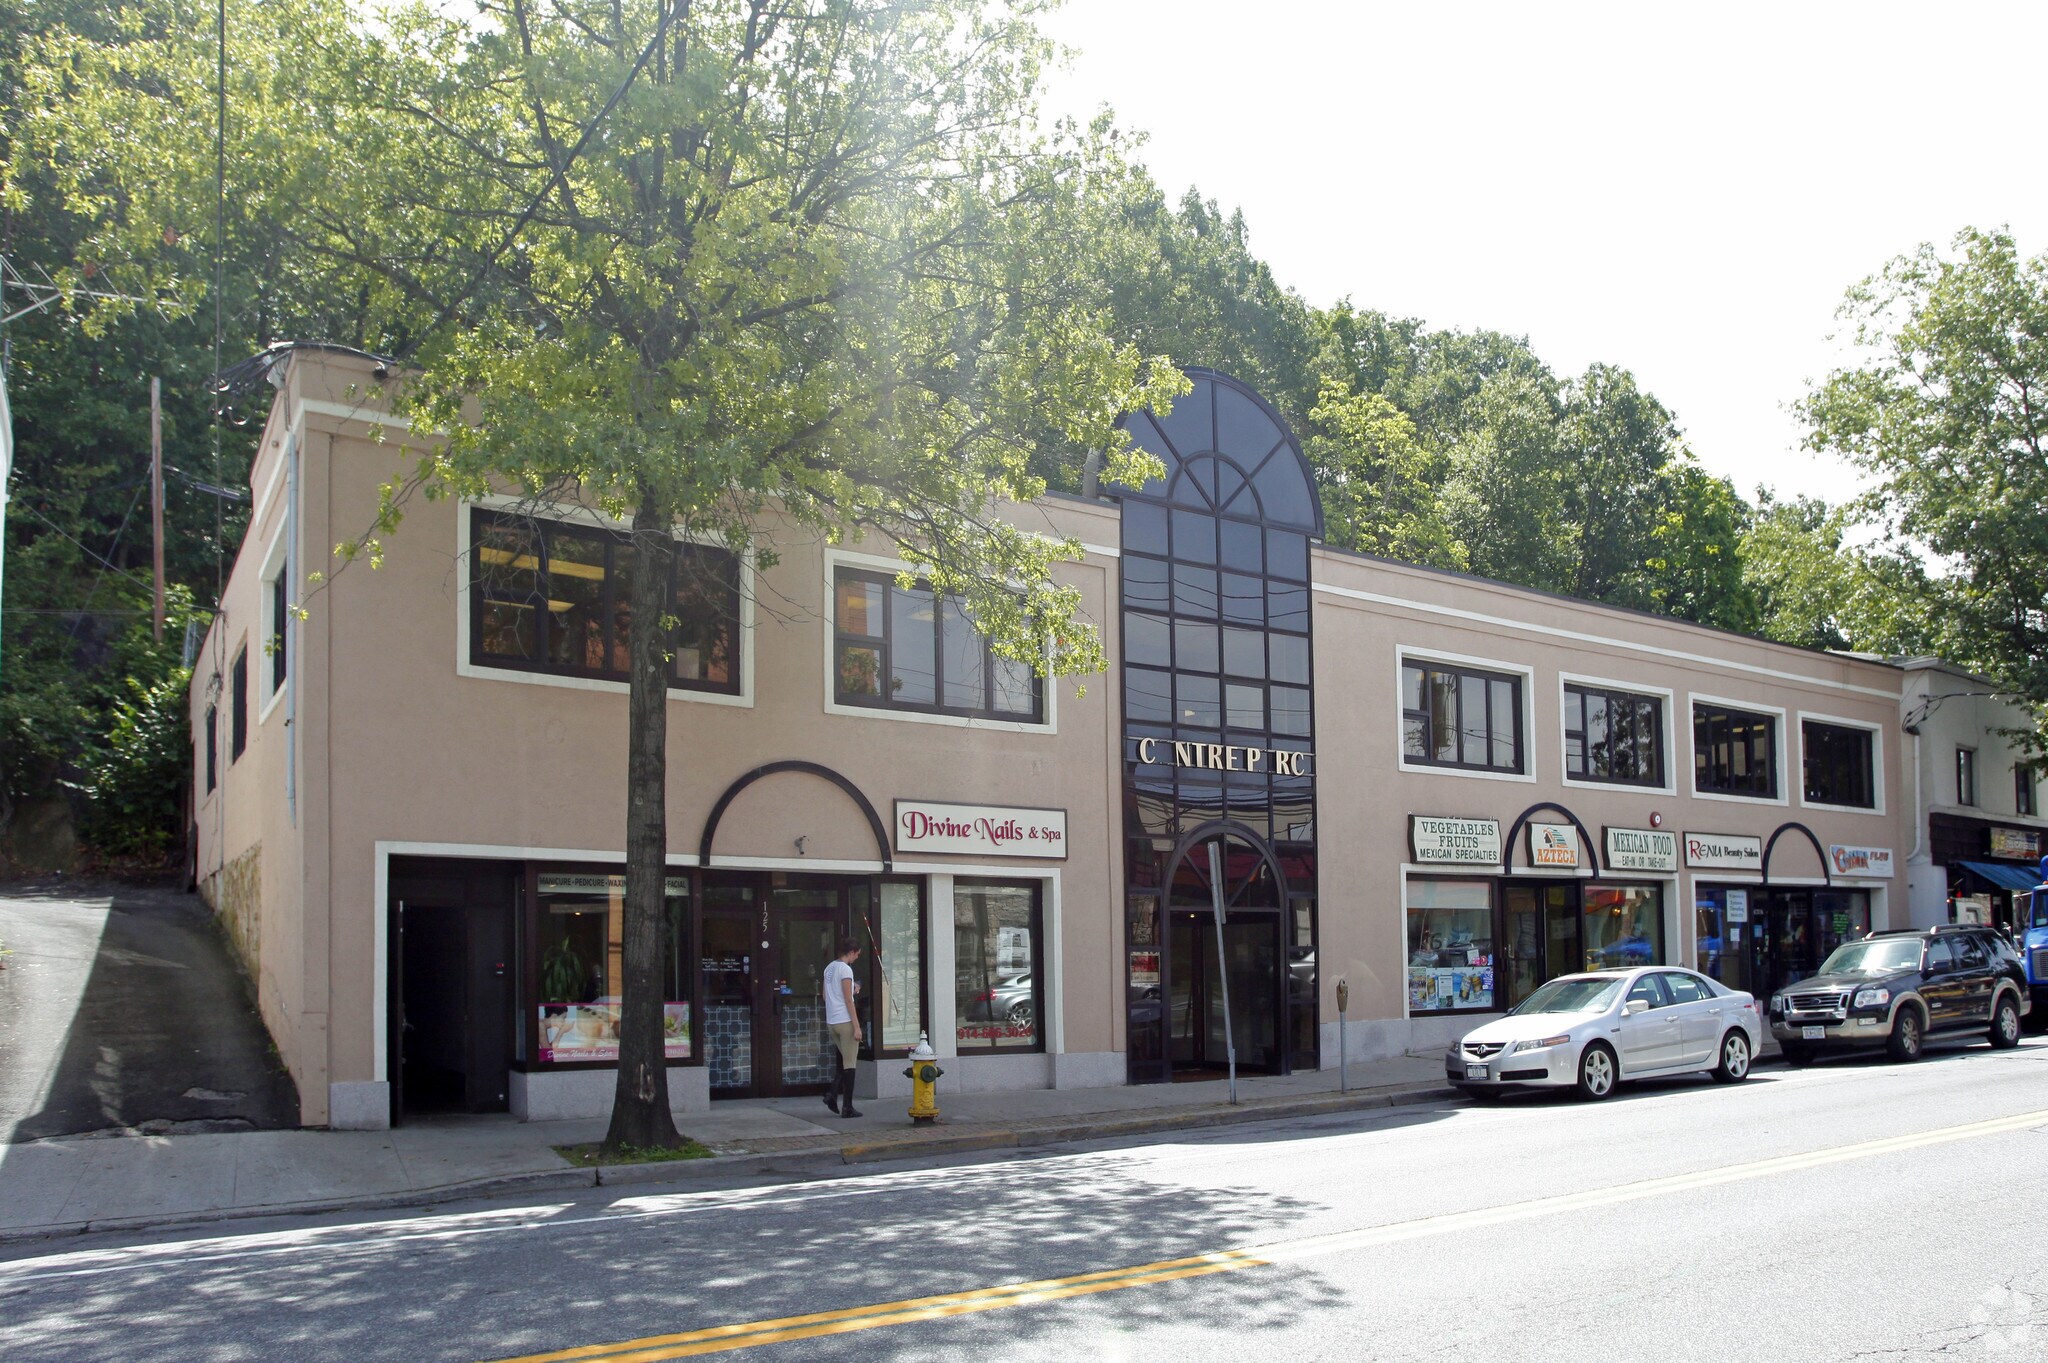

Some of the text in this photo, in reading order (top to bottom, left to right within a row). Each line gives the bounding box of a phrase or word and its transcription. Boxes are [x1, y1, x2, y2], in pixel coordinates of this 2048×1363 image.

[902, 811, 1061, 846] Divine Nails & Spa
[1421, 821, 1494, 836] VEGETABLES
[1439, 835, 1478, 848] FRUITS
[1613, 832, 1672, 855] MEXICAN FOOD
[1420, 848, 1497, 861] MEXICAN SPECIALTIES
[1537, 848, 1576, 864] AZTECA
[1639, 857, 1645, 867] OR
